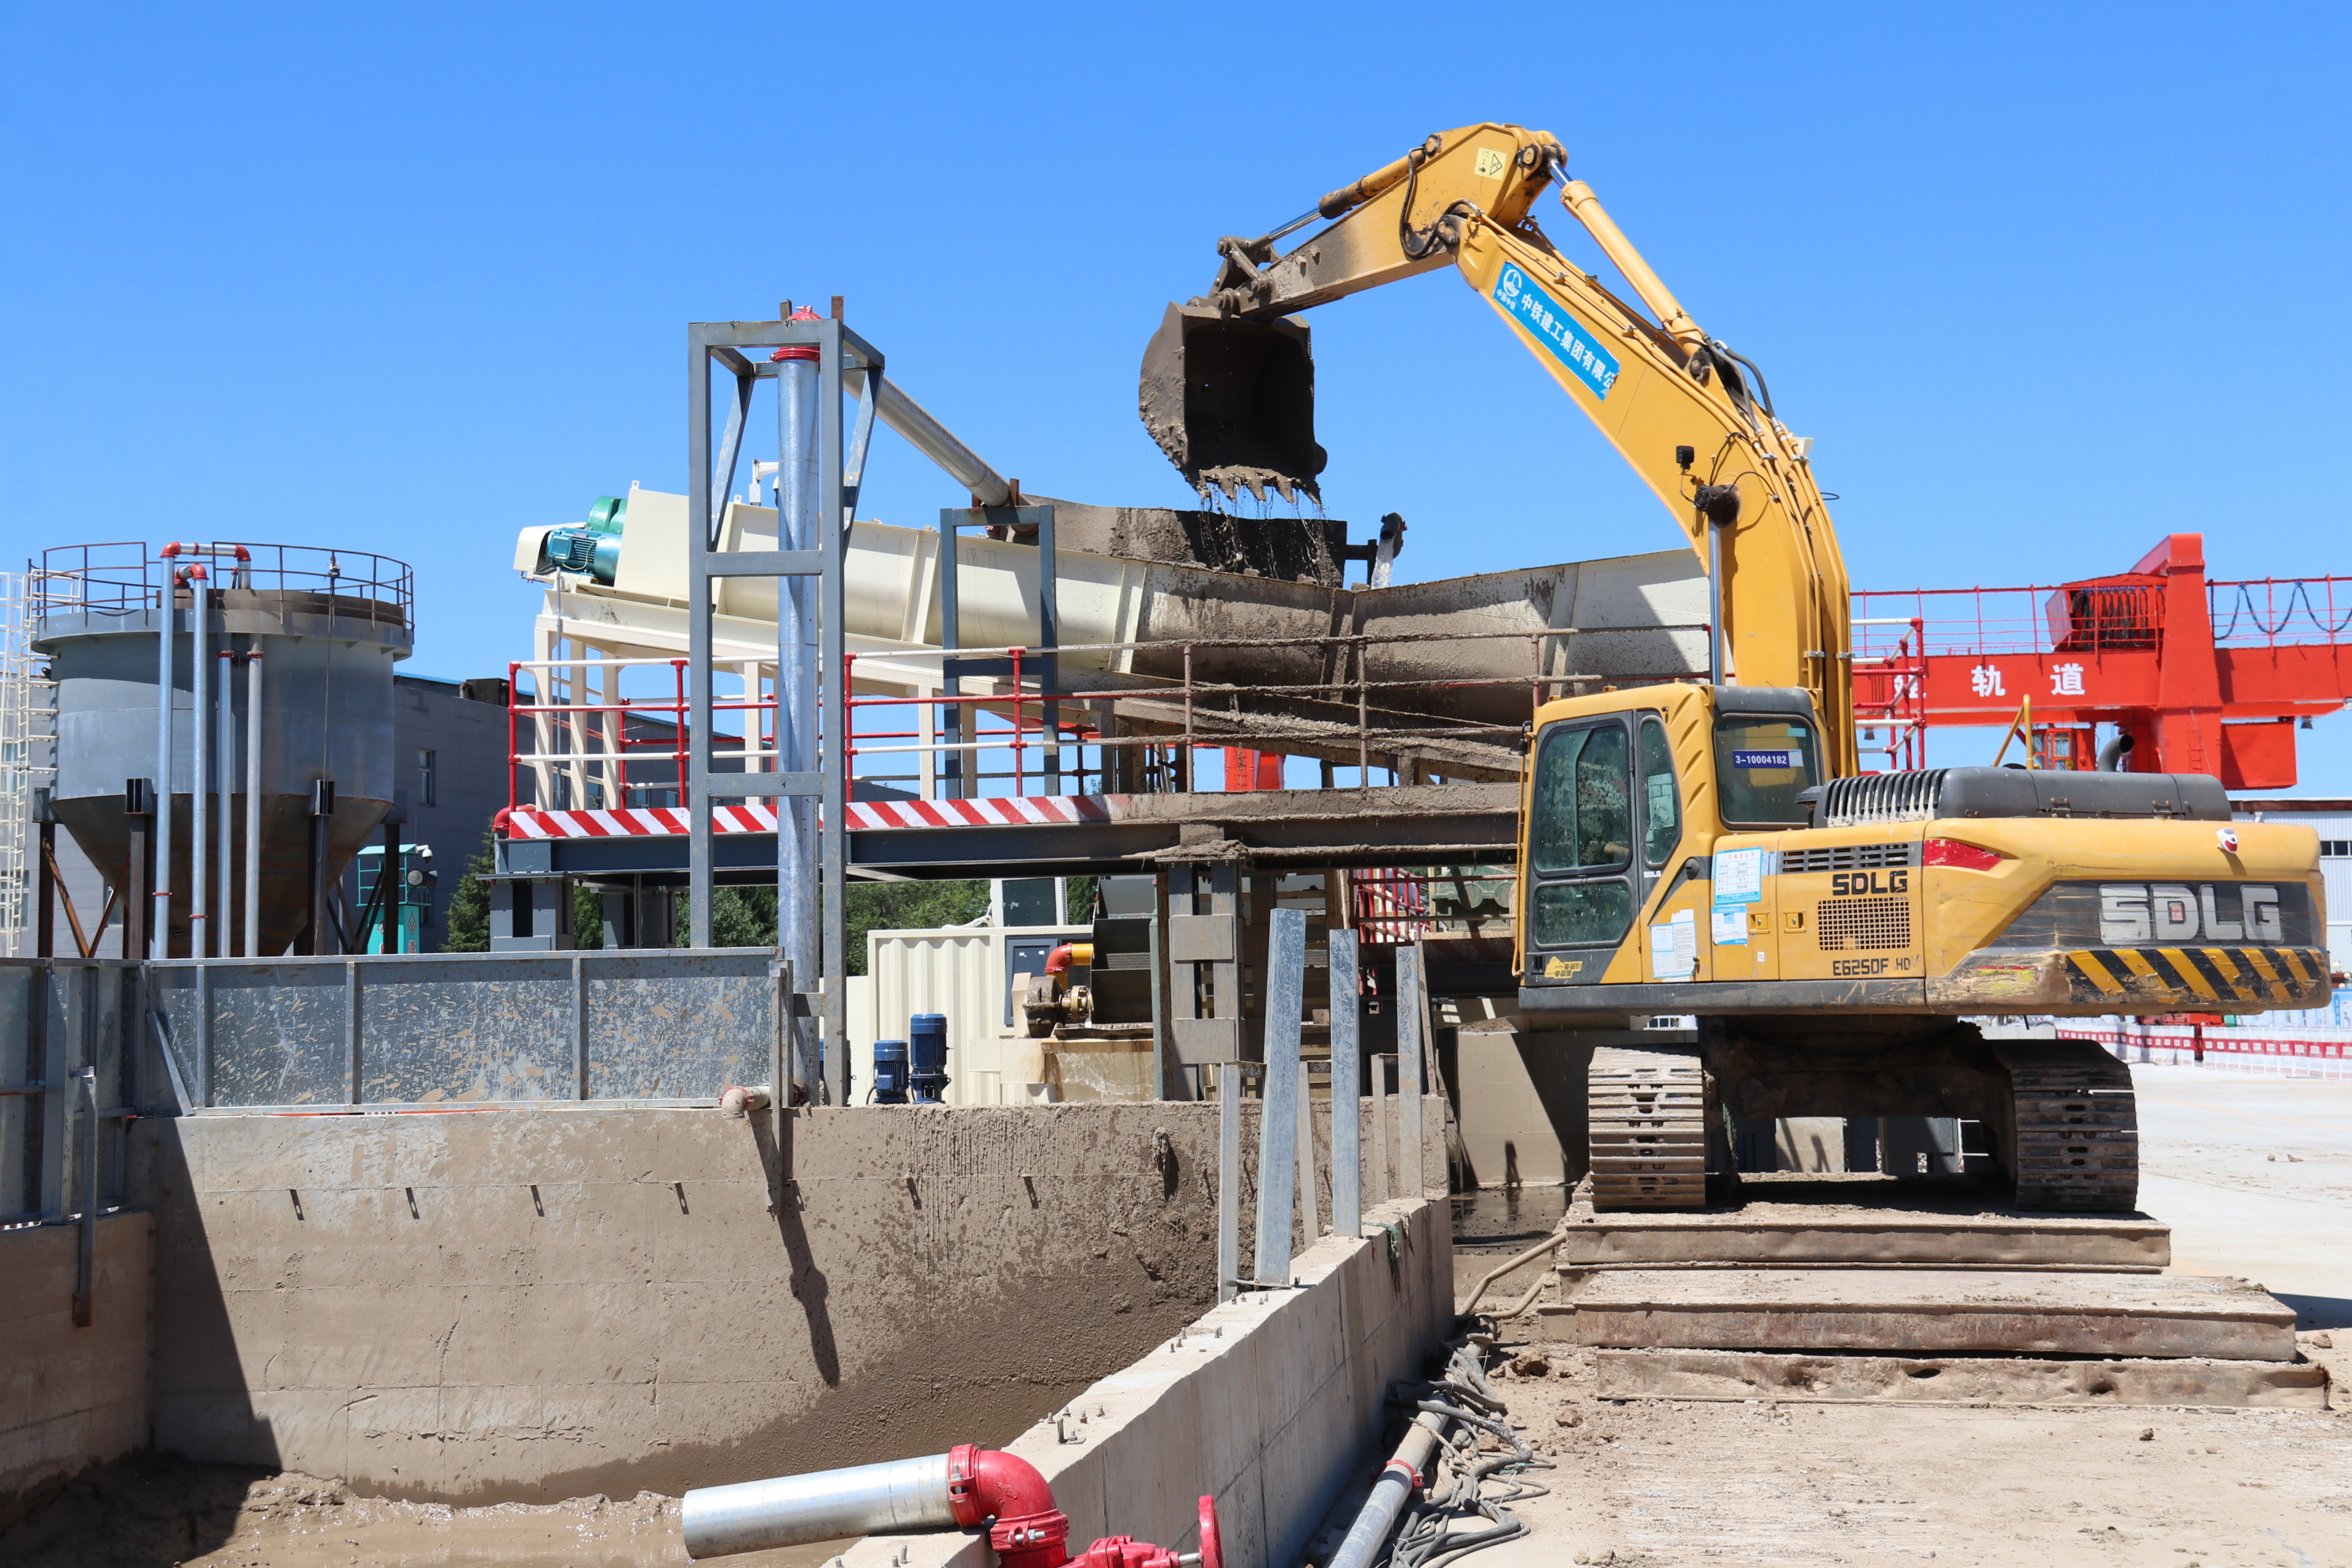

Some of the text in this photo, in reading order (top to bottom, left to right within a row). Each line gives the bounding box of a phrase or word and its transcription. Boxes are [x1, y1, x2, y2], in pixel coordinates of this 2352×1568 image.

[1496, 288, 1516, 311] 中国中铁
[1521, 293, 1615, 389] 中铁建工集团有限公
[1735, 755, 1787, 764] 3-10004182
[1832, 870, 1907, 895] SDLG
[2099, 884, 2283, 945] SDLG
[1833, 958, 1910, 976] E6250F HD
